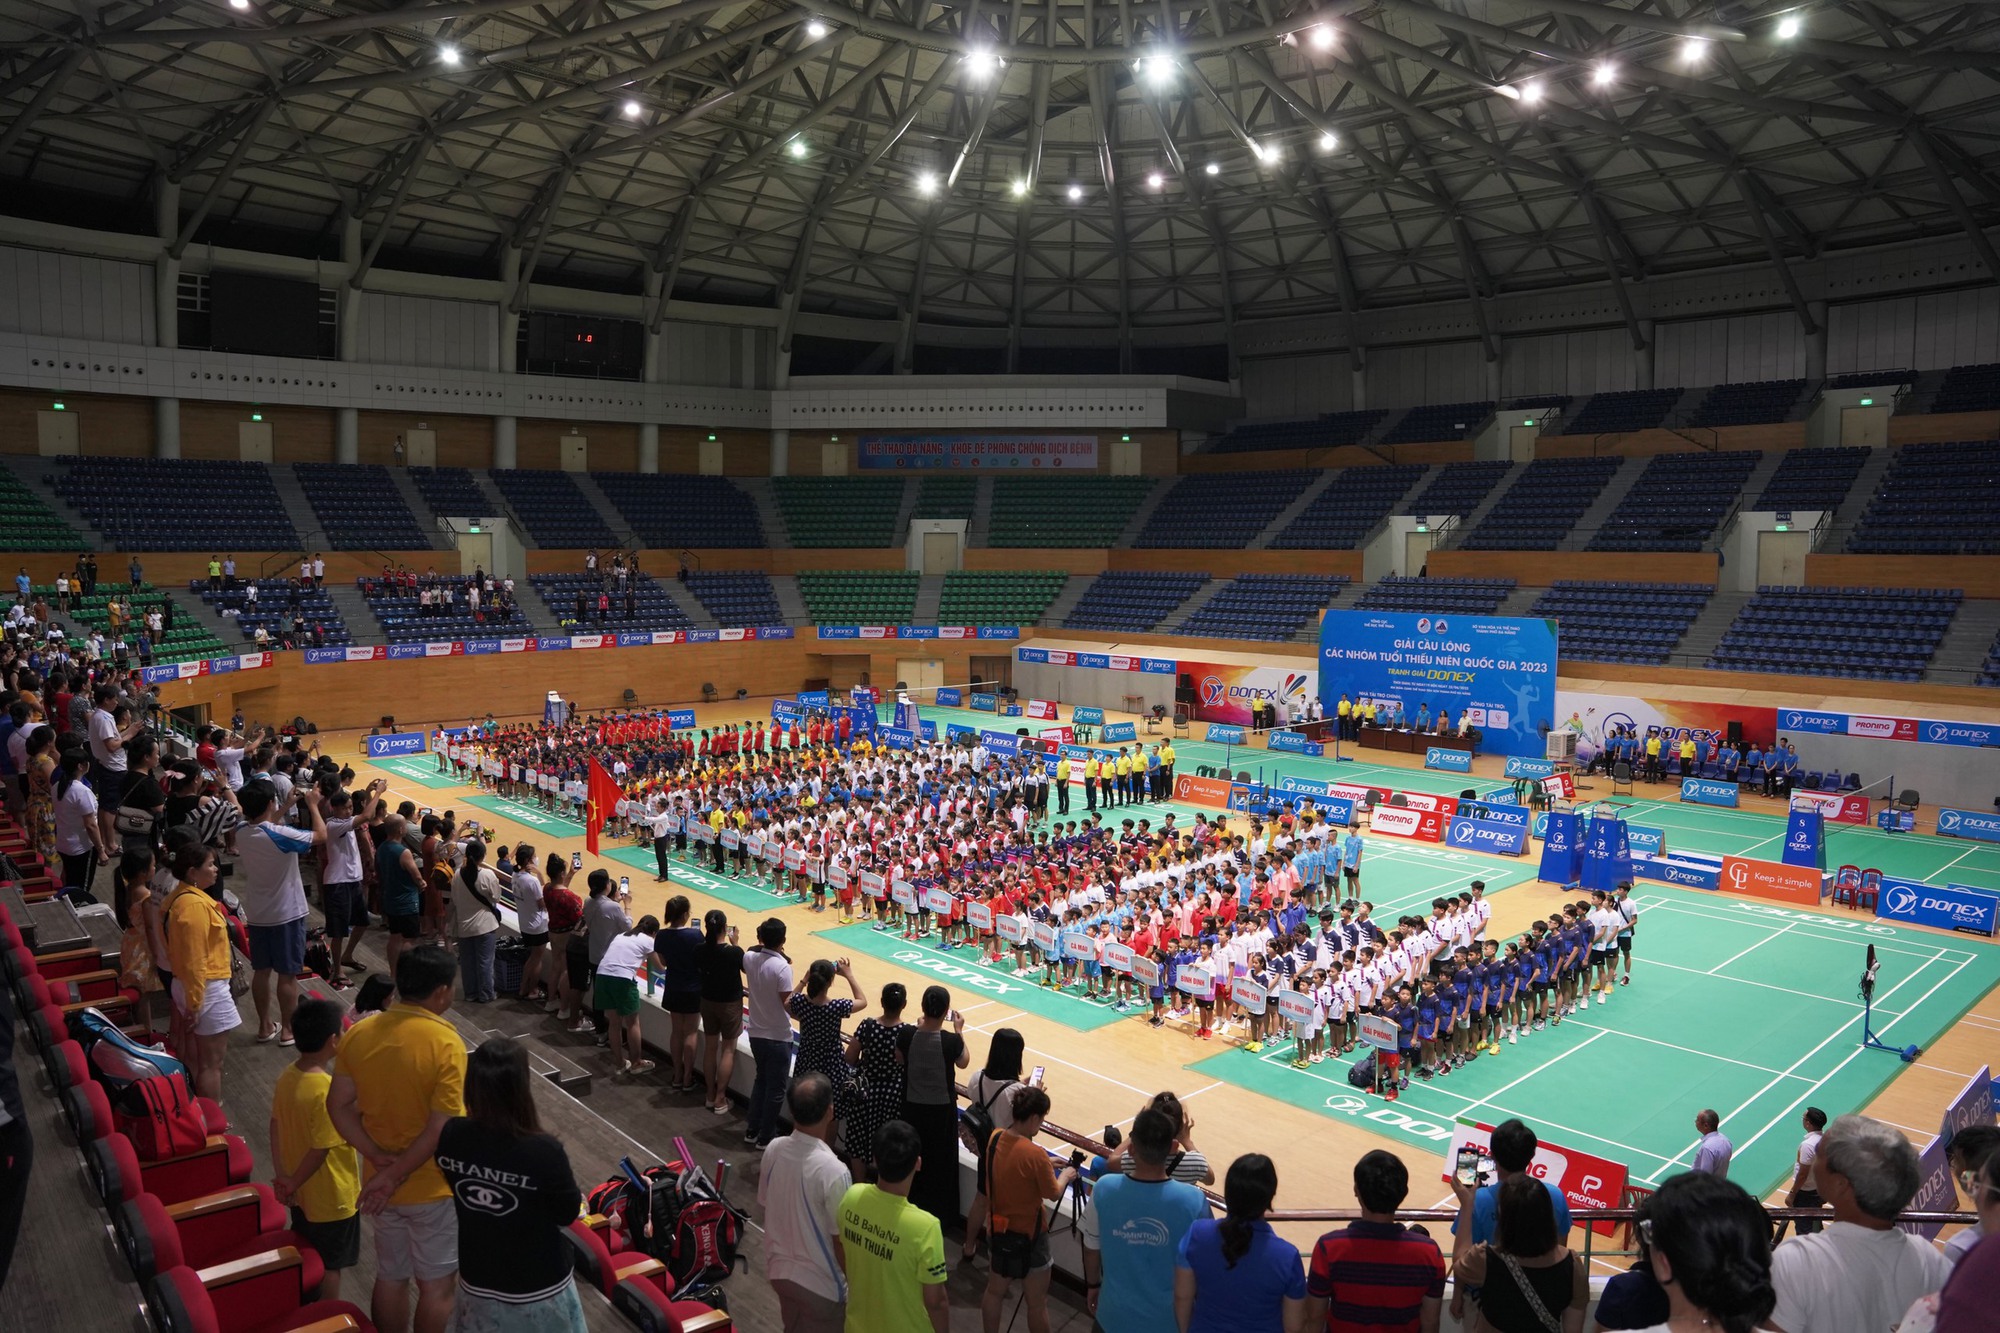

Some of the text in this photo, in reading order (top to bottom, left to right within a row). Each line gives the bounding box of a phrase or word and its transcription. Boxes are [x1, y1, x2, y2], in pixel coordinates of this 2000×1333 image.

[884, 441, 905, 455] THAO
[1394, 637, 1471, 653] GIẢI CẦU LÔNG
[1325, 646, 1548, 673] CÁC NHÓM TUỔI THIẾU NIÊN QUỐC GIA 2023
[1388, 668, 1476, 683] TRANH GIẢI DONEX
[1229, 686, 1277, 700] DONEX
[1805, 717, 1839, 726] DONEX
[1855, 721, 1890, 730] PRONING
[1951, 728, 1991, 739] DONEX
[390, 738, 420, 747] DONEX
[1282, 736, 1305, 744] DONEX
[1442, 754, 1470, 763] DONEX
[1522, 763, 1552, 773] DONEX
[1193, 785, 1205, 793] Keep
[1210, 787, 1225, 797] simple
[1297, 784, 1326, 795] DONEX
[1330, 789, 1366, 800] PRONING
[1701, 785, 1737, 796] DONEX
[1313, 802, 1348, 816] DONEX
[1378, 813, 1413, 825] PRONING
[1557, 820, 1563, 828] 5
[1799, 819, 1805, 827] 8
[1964, 818, 2000, 830] DONE
[1476, 829, 1517, 843] DONEX
[1627, 831, 1660, 843] ONEX
[1678, 872, 1705, 882] DONEX
[1754, 872, 1775, 884] Keep
[1777, 875, 1783, 883] it
[1784, 877, 1813, 889] simple
[1921, 897, 1988, 918] DONEX
[1952, 913, 1982, 924] Sport
[1077, 944, 1088, 953] MAU
[921, 955, 1023, 994] DONEX
[1362, 1024, 1392, 1041] HẢI PHÒNG
[1363, 1109, 1453, 1141] DON
[437, 1155, 538, 1192] CHANEL
[1918, 1164, 1946, 1210] DONEX
[1566, 1190, 1607, 1210] PRONING
[844, 1209, 900, 1245] CLB BaNaNa
[701, 1223, 711, 1255] YONEX
[844, 1226, 894, 1262] NINH THUẬN
